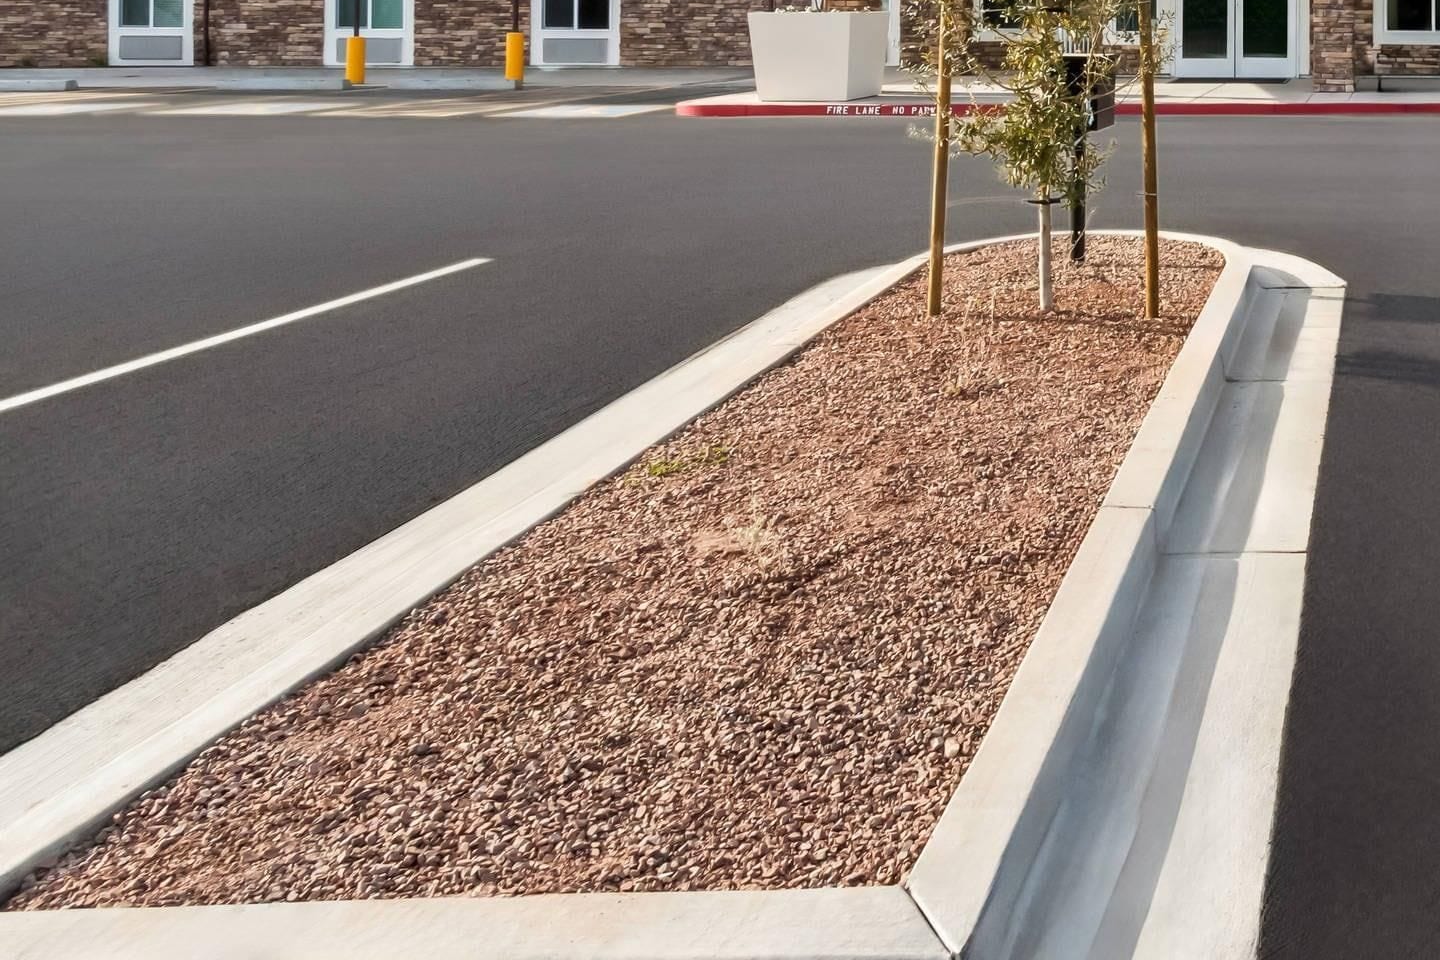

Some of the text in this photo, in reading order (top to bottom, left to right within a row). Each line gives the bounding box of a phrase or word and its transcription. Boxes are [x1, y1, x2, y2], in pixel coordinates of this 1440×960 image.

[826, 106, 849, 115] FIRE
[855, 106, 881, 115] LANE
[892, 106, 905, 115] NO
